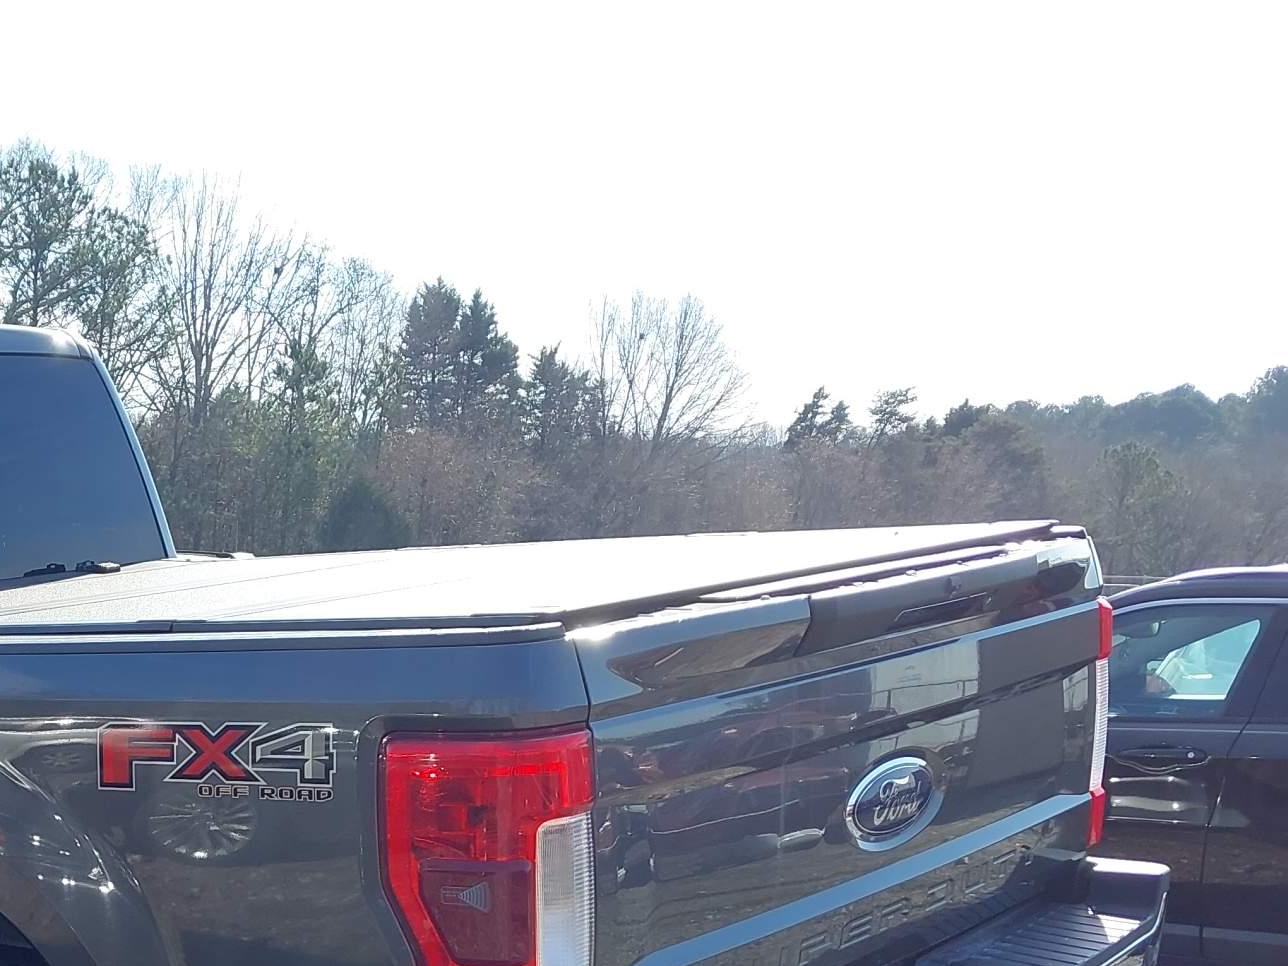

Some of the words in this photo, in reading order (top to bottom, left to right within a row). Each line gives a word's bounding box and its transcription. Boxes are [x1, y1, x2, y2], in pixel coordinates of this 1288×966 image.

[97, 721, 337, 791] FX4
[197, 784, 249, 799] OFF
[258, 785, 334, 803] ROAD
[872, 773, 923, 825] Ford
